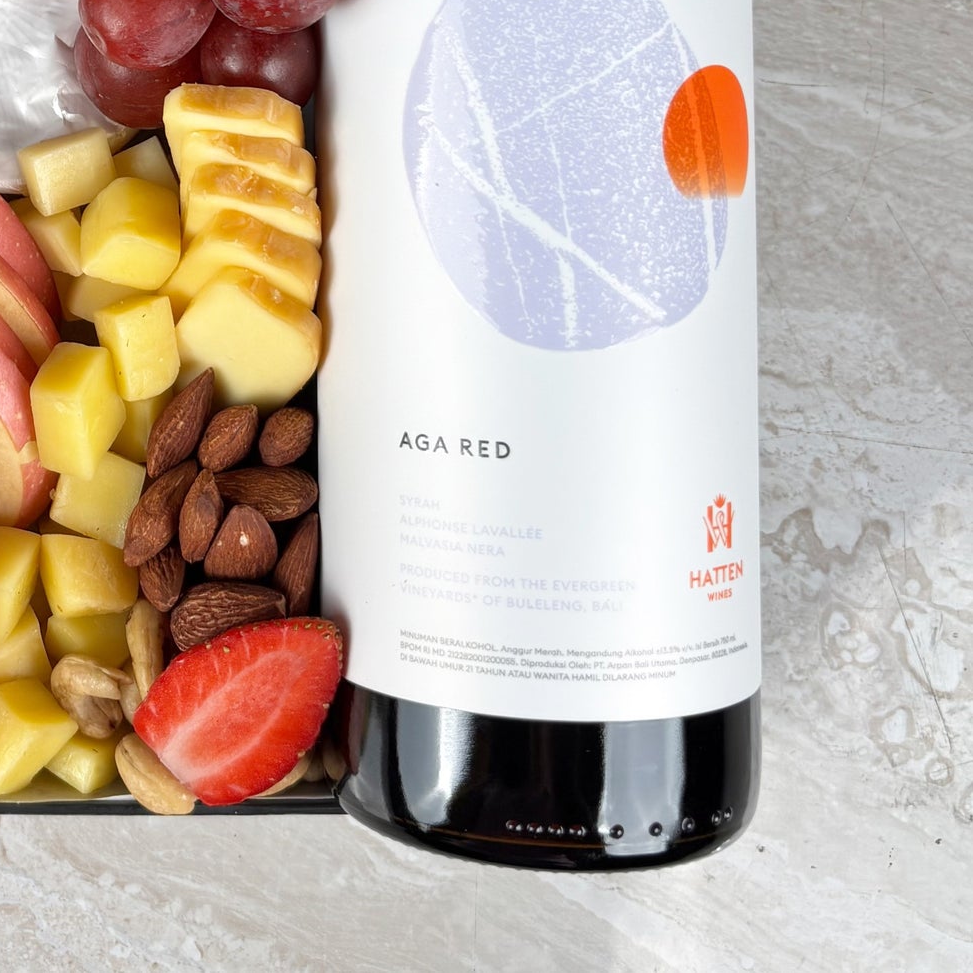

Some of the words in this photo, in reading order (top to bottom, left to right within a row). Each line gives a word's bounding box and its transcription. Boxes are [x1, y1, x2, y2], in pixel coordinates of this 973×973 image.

[399, 431, 449, 454] AGA
[460, 438, 511, 459] RED
[399, 494, 440, 510] SYRAH
[399, 514, 468, 534] ALPHONSE
[400, 533, 464, 553] MALVASIA
[467, 542, 506, 557] NERA
[400, 562, 470, 584] PRODUCED
[474, 574, 515, 588] FROM
[521, 578, 548, 590] THE
[553, 579, 636, 592] EVERGREEN
[689, 559, 743, 589] HATTEN
[482, 594, 502, 607] OF
[506, 596, 587, 613] BULELENG,
[707, 588, 733, 602] WINES
[400, 629, 438, 644] MINUMAN
[501, 645, 533, 656] Anggur
[567, 648, 623, 659] Mengandung
[400, 640, 422, 652] BPOM
[432, 647, 446, 657] MD
[520, 658, 567, 669] Diproduksi
[409, 653, 438, 668] BAWAH
[439, 659, 465, 672] UMUR
[466, 663, 474, 673] 21
[476, 665, 506, 677] TAHUN
[508, 669, 532, 679] ATAU
[533, 671, 571, 681] WANITA
[572, 673, 601, 682] HAMIL
[602, 672, 647, 683] DILARANG
[648, 670, 676, 681] MINUM
